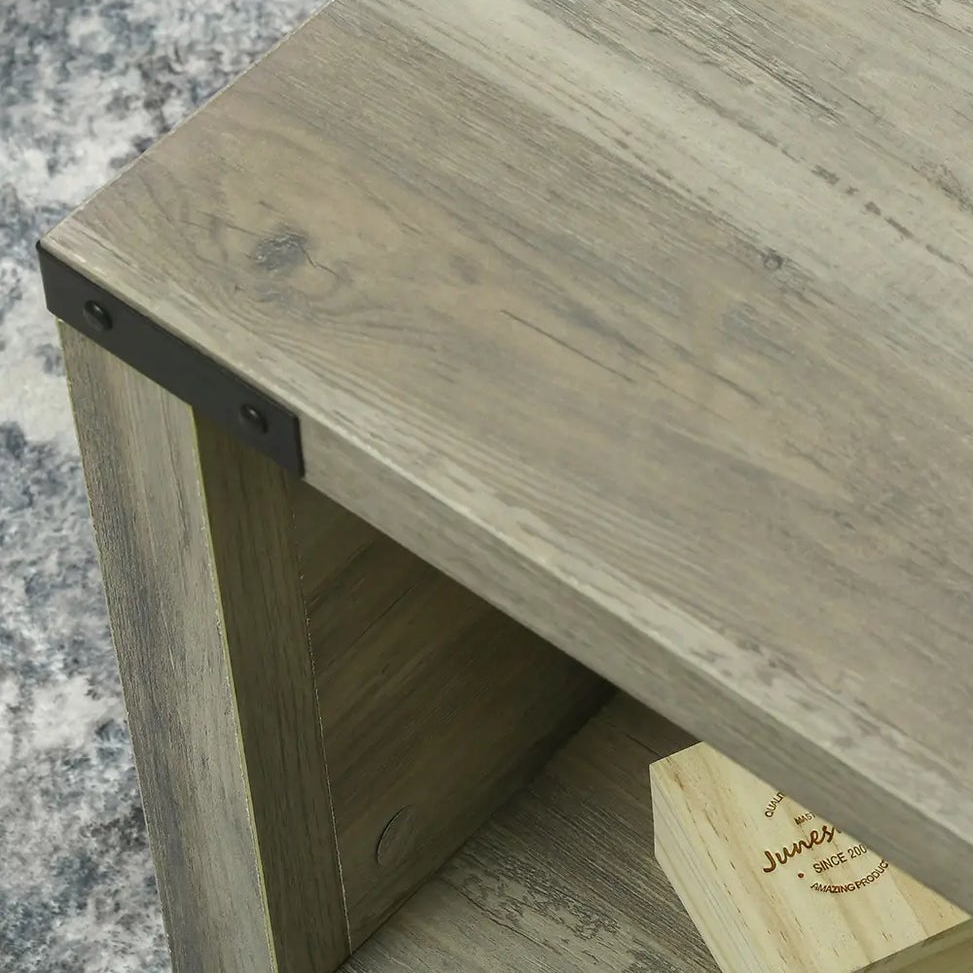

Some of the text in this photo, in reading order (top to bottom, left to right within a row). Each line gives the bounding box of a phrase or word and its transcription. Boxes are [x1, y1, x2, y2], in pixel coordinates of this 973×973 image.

[812, 844, 868, 874] SINCE 200
[810, 859, 889, 894] AMAZING PRODUC
